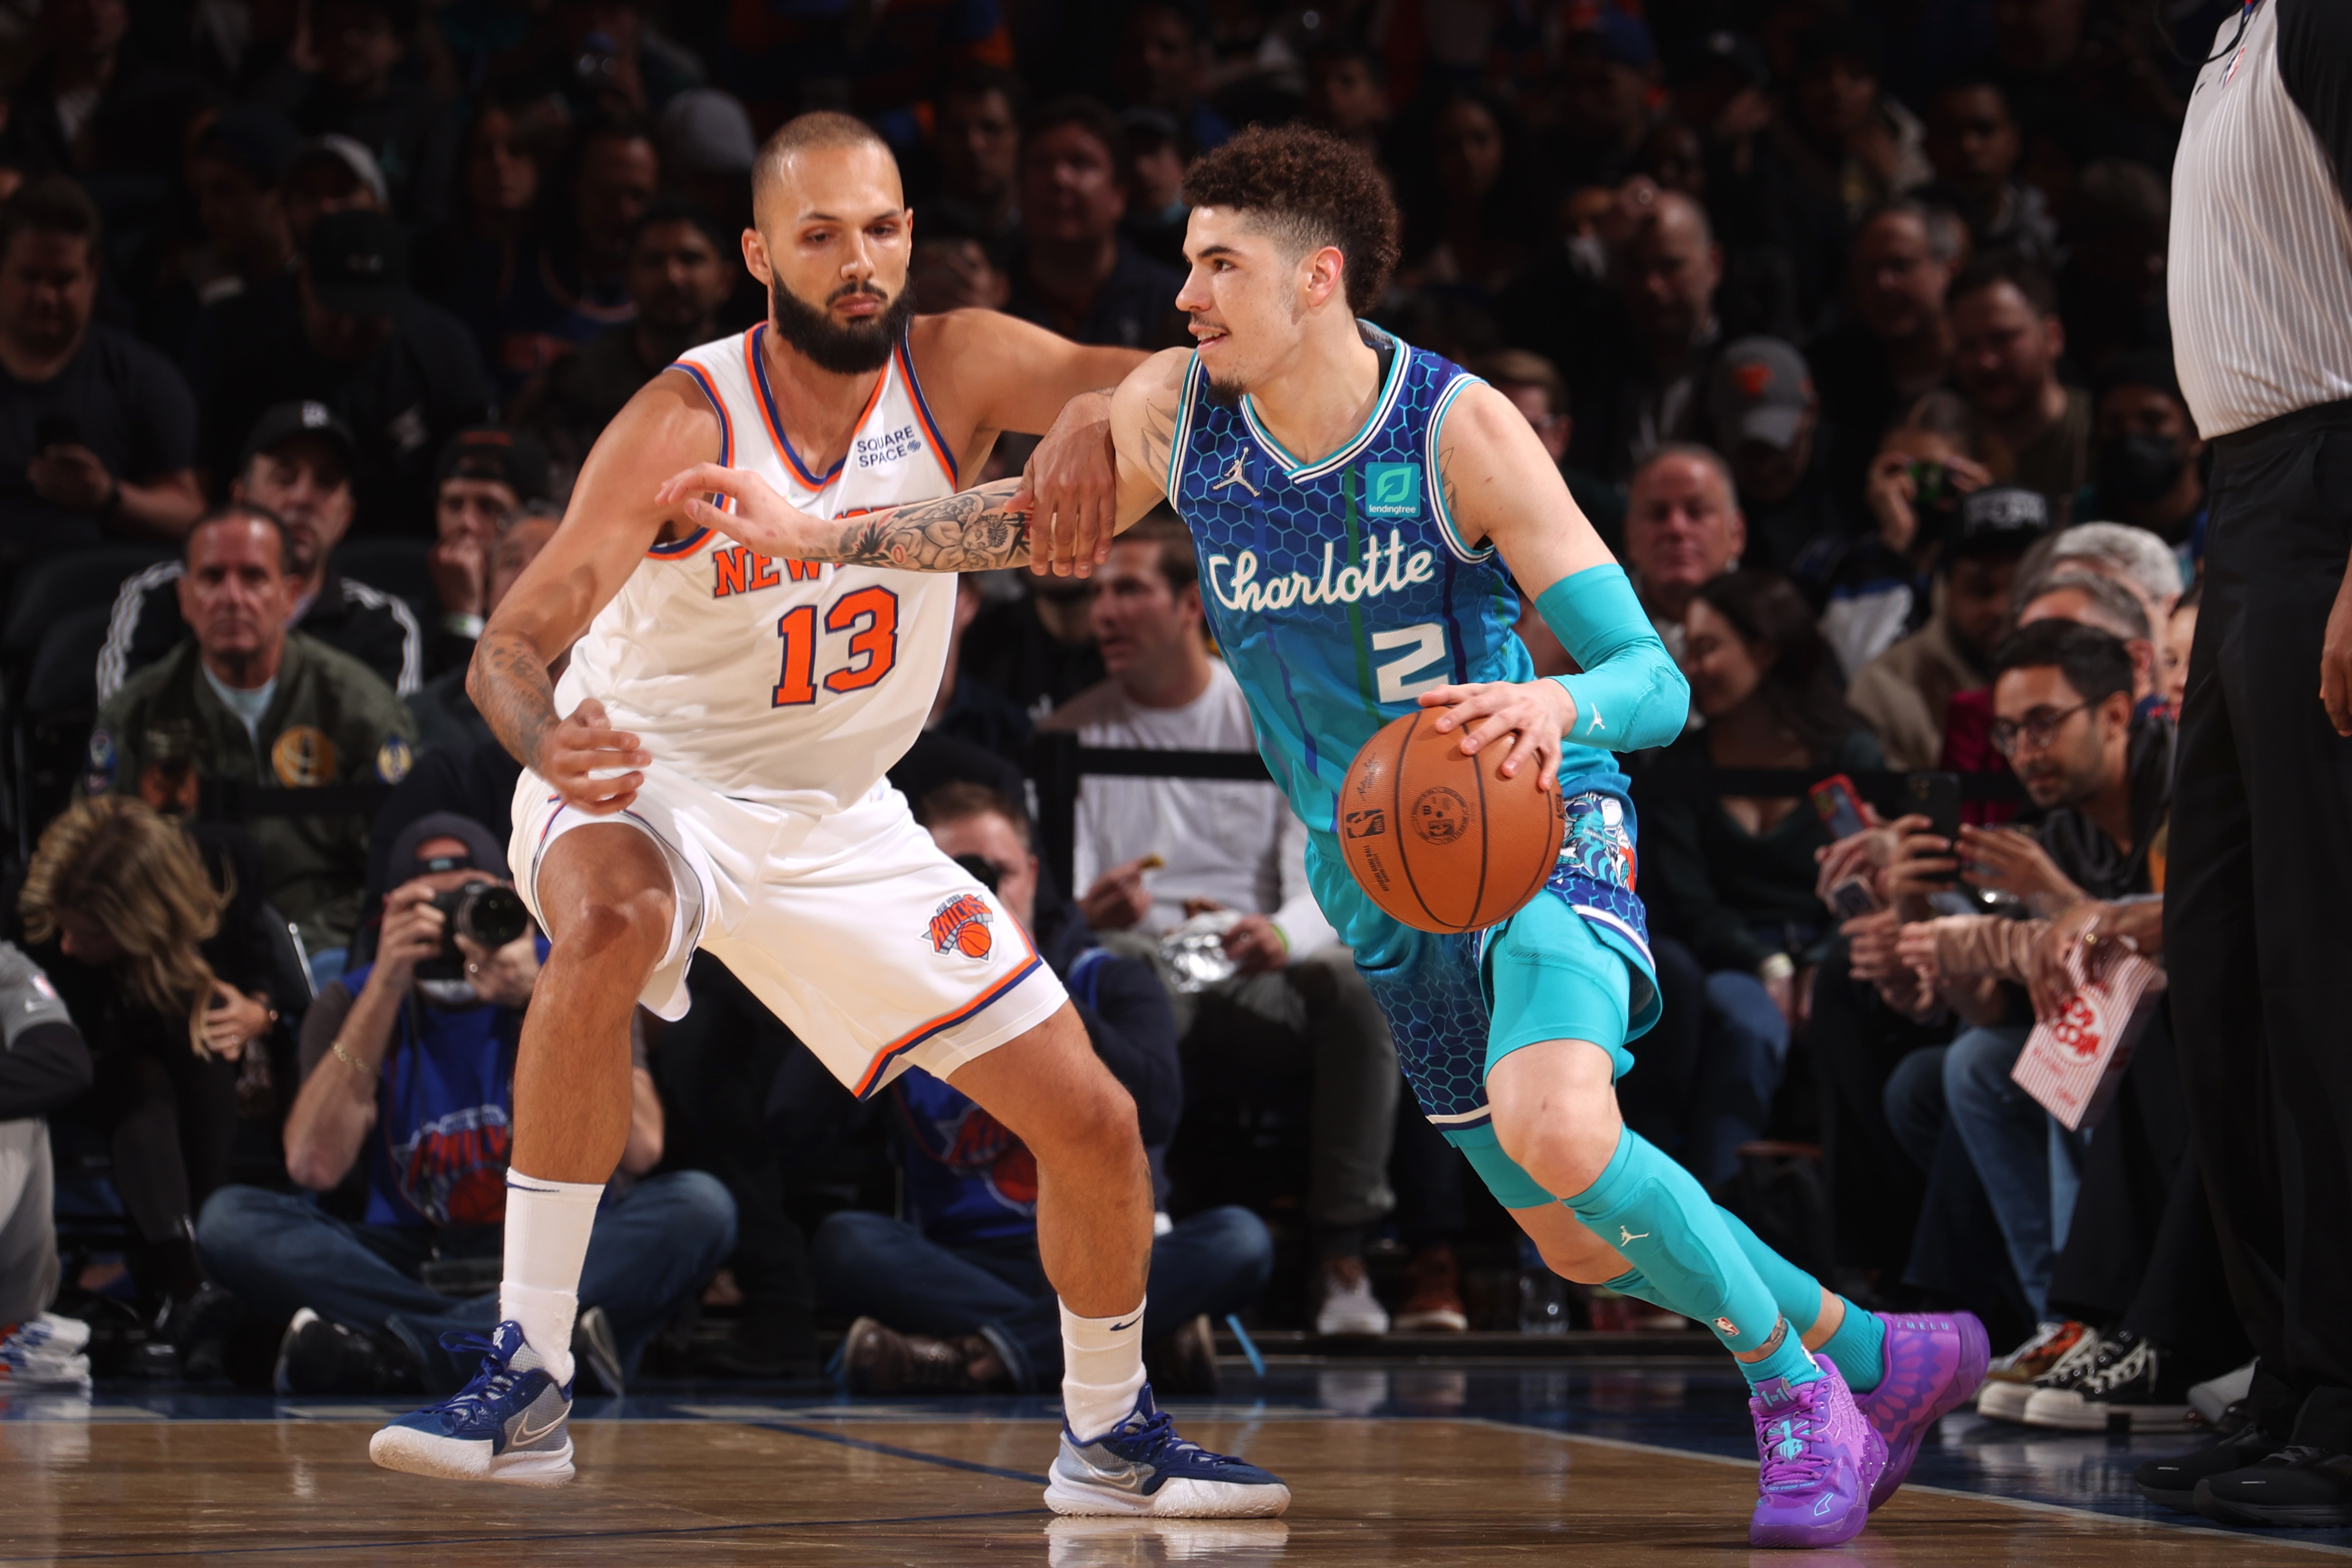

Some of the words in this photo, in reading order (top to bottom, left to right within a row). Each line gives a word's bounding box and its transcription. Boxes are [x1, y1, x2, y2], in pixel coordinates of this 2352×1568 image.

[857, 425, 915, 453] SQUARE
[859, 444, 907, 468] SPACE
[1369, 504, 1416, 515] lendingtree
[1209, 528, 1434, 612] Charlotte
[771, 584, 899, 708] 13
[1371, 622, 1450, 704] 2
[929, 894, 992, 952] KNICKS
